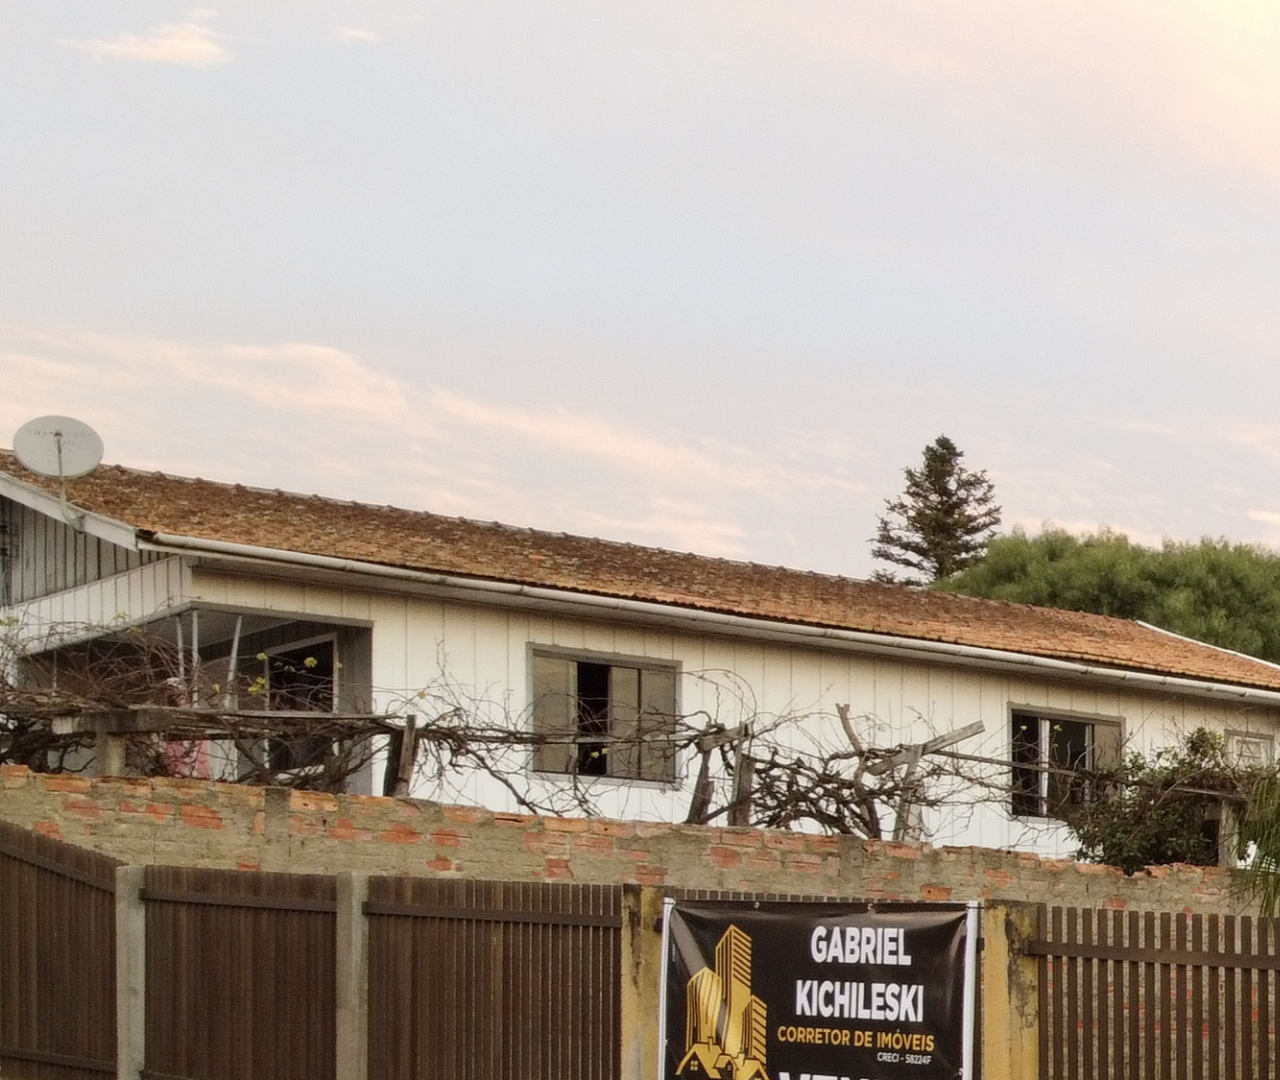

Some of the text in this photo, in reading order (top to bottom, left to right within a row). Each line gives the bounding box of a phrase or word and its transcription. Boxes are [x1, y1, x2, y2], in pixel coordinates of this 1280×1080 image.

[811, 926, 911, 965] GABRIEL
[796, 980, 924, 1022] KICHILESKI
[778, 1025, 934, 1052] CORRETOR DE IMÓVEIS
[877, 1052, 898, 1062] CRECI
